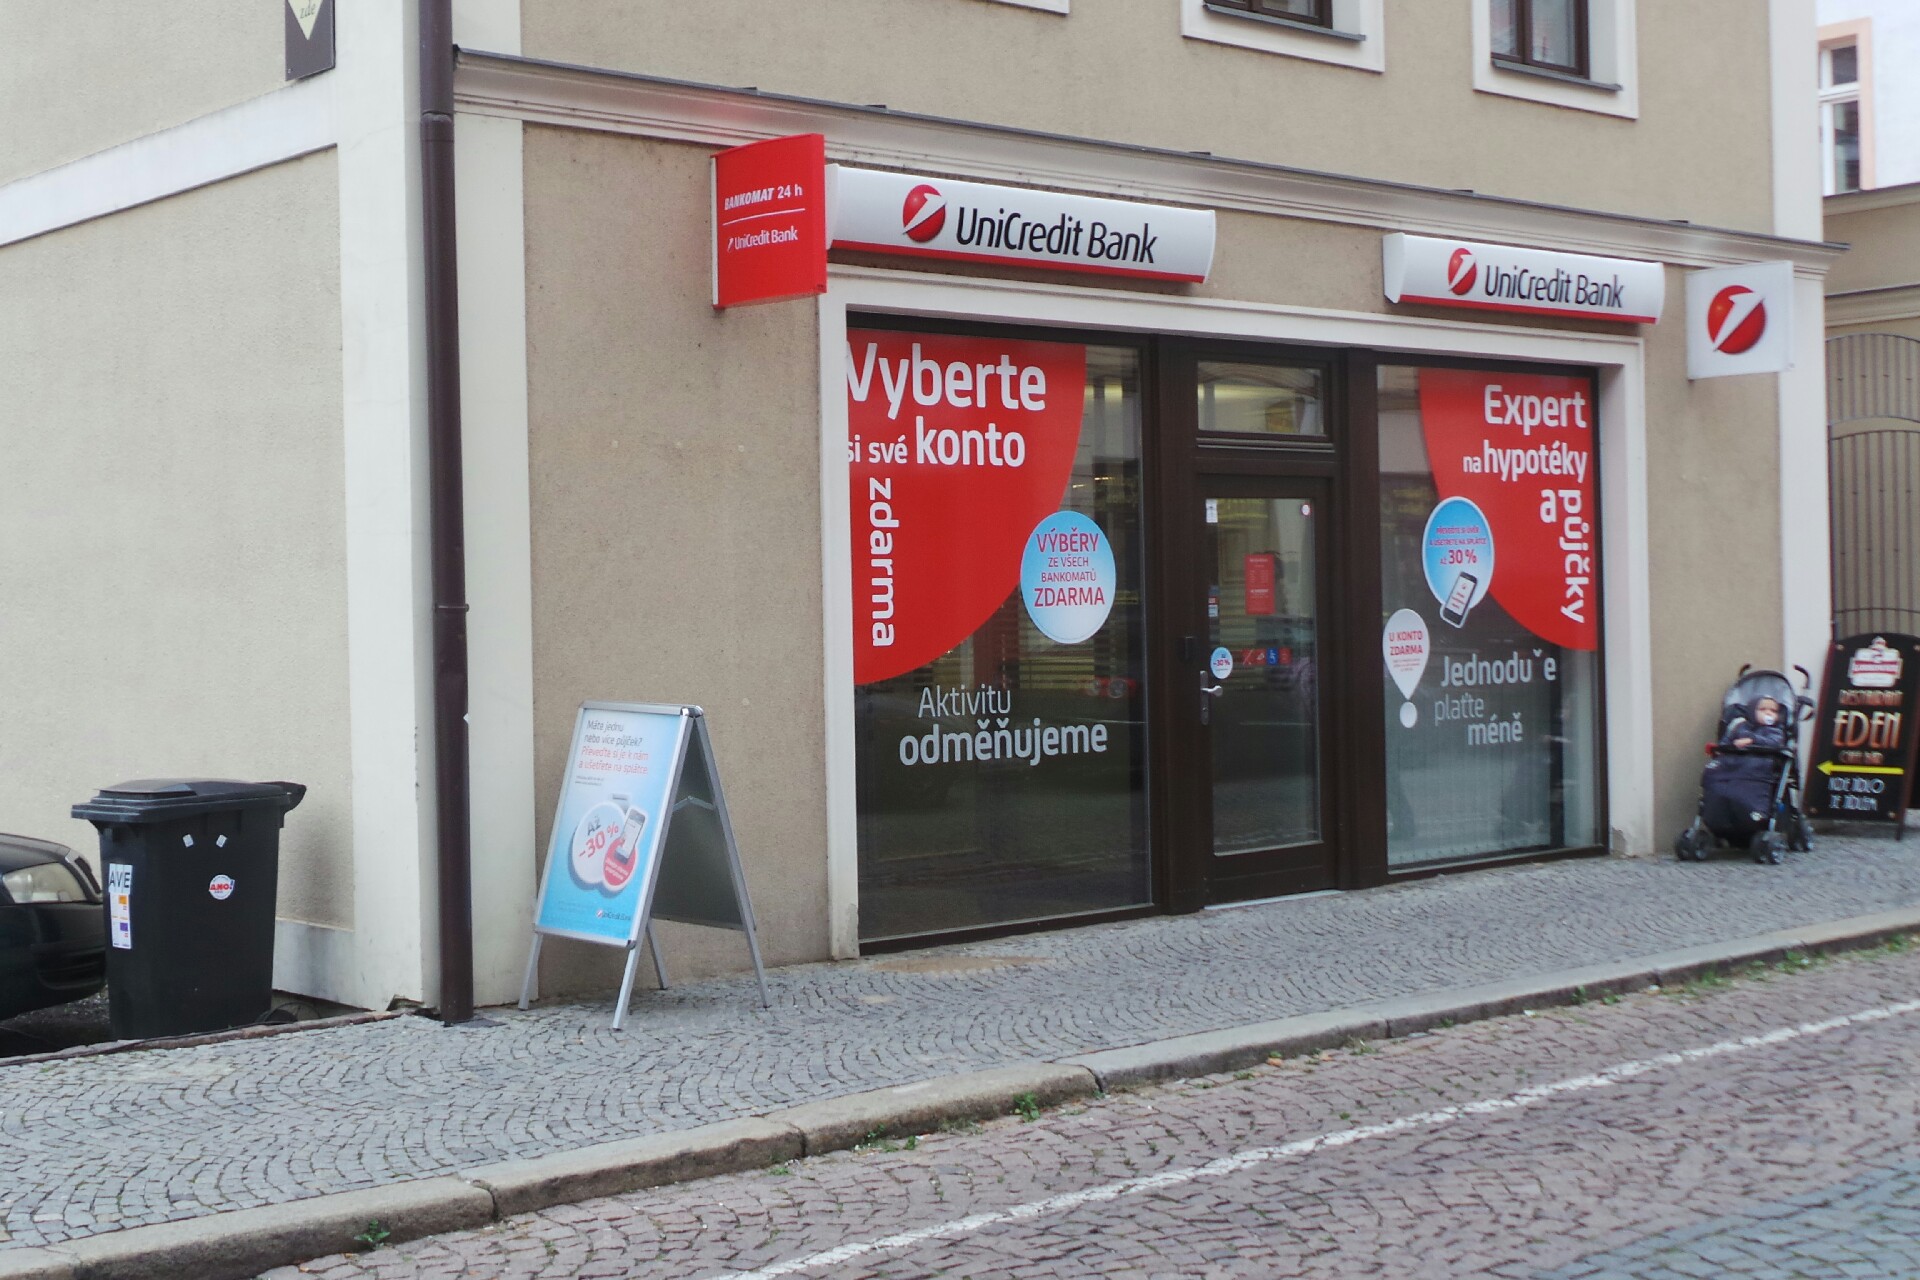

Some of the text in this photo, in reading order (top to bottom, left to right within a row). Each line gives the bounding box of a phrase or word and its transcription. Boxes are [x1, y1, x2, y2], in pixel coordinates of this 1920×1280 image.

[724, 183, 803, 211] BANKOMAT 24 h
[735, 225, 798, 250] UniCredit Bank
[956, 207, 1158, 265] UniCredit Bank
[1484, 265, 1625, 309] UniCredit Bank
[847, 342, 1046, 420] Vyberte
[1484, 384, 1587, 436] Expert
[868, 434, 908, 464] své
[915, 415, 1025, 467] konto
[1463, 439, 1588, 483] na hypotéky
[1540, 488, 1557, 523] a
[1036, 527, 1099, 553] VÝBĚRY
[1558, 489, 1590, 624] půjčky
[869, 477, 899, 647] zdarma
[1041, 568, 1097, 582] BANKOMATŮ
[1048, 554, 1089, 568] ZE VŠECH
[1034, 587, 1105, 608] ZDARMA
[918, 684, 1012, 718] Aktivitu
[899, 717, 1108, 766] odměňujeme
[1467, 712, 1524, 746] méně
[1833, 709, 1903, 750] EDEN
[109, 871, 131, 888] AVE
